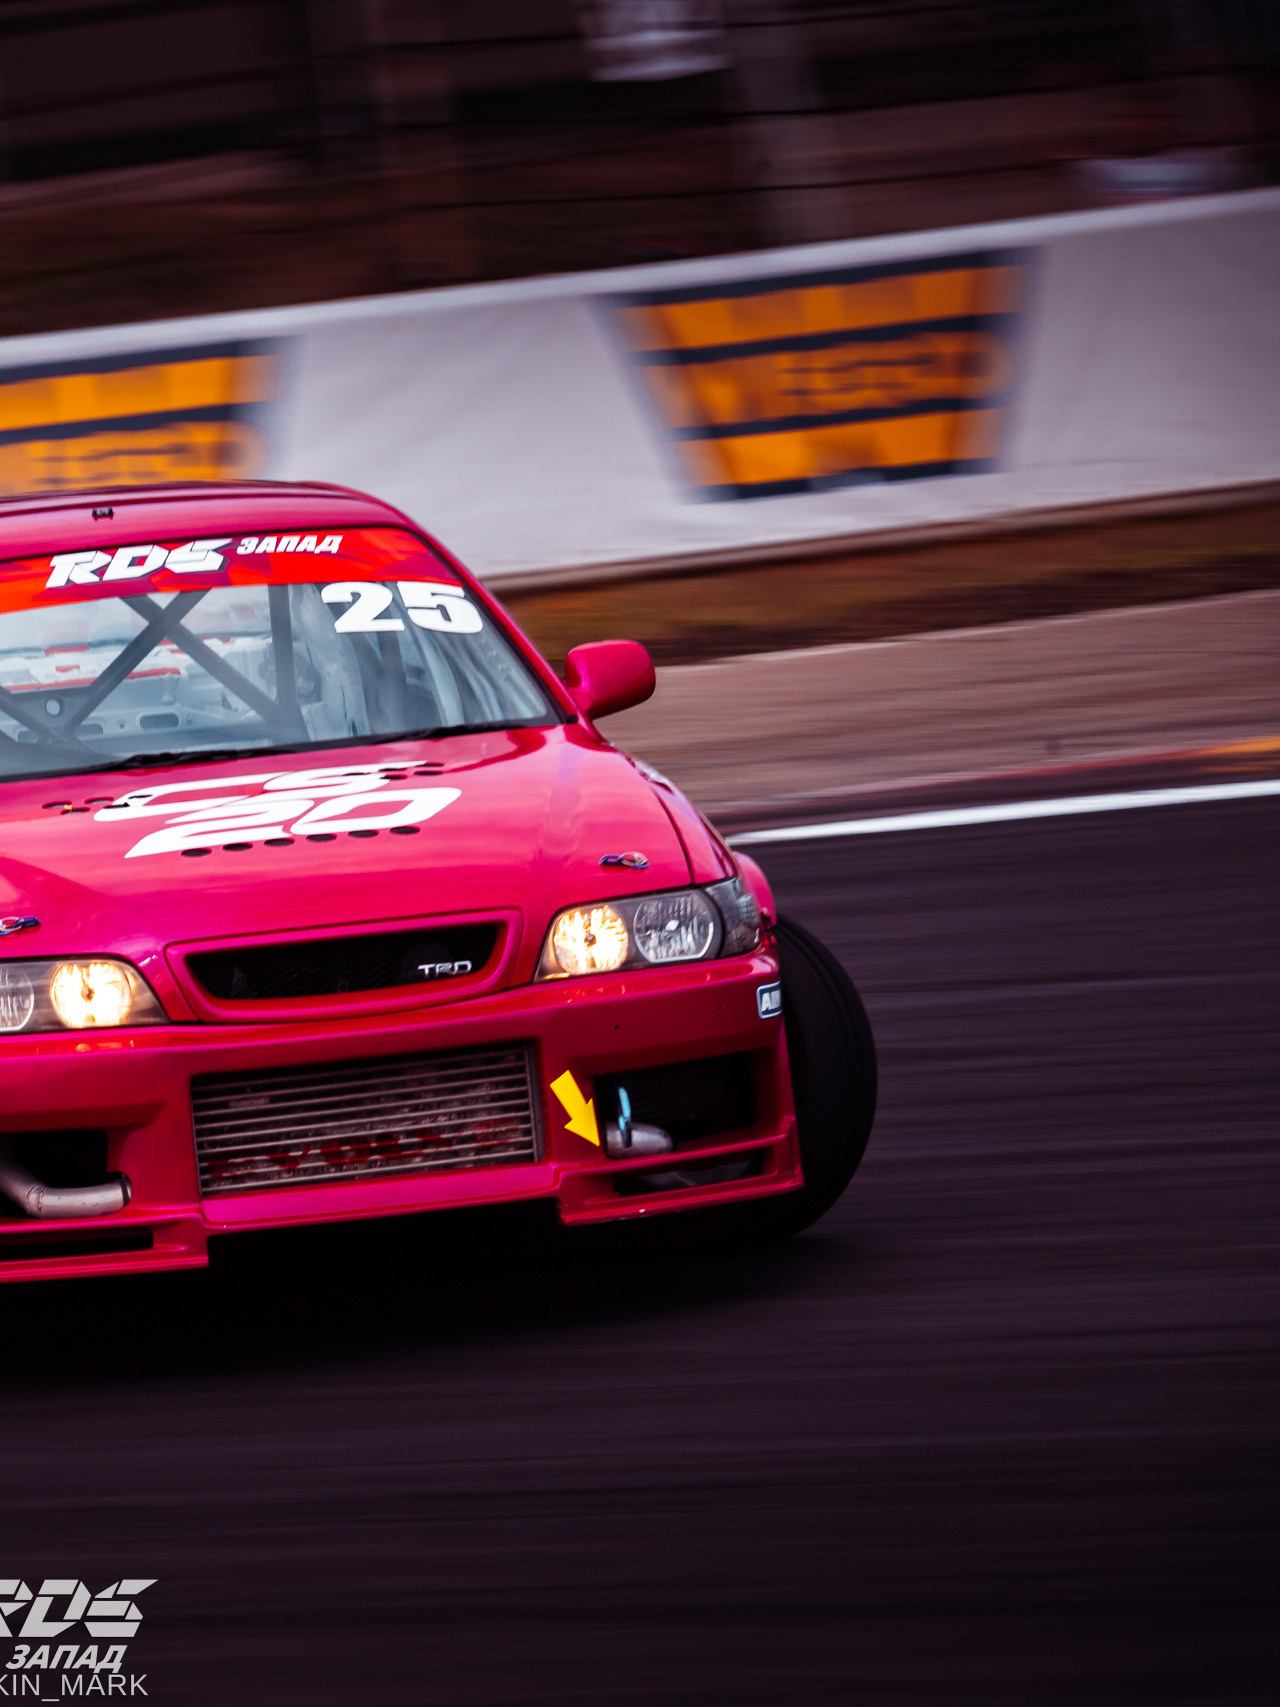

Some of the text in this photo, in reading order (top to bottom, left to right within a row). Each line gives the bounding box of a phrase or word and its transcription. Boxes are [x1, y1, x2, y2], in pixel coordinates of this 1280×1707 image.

[236, 534, 344, 555] ЗАПАД
[45, 538, 233, 588] RDS
[321, 581, 484, 634] 25
[417, 960, 472, 977] TRD
